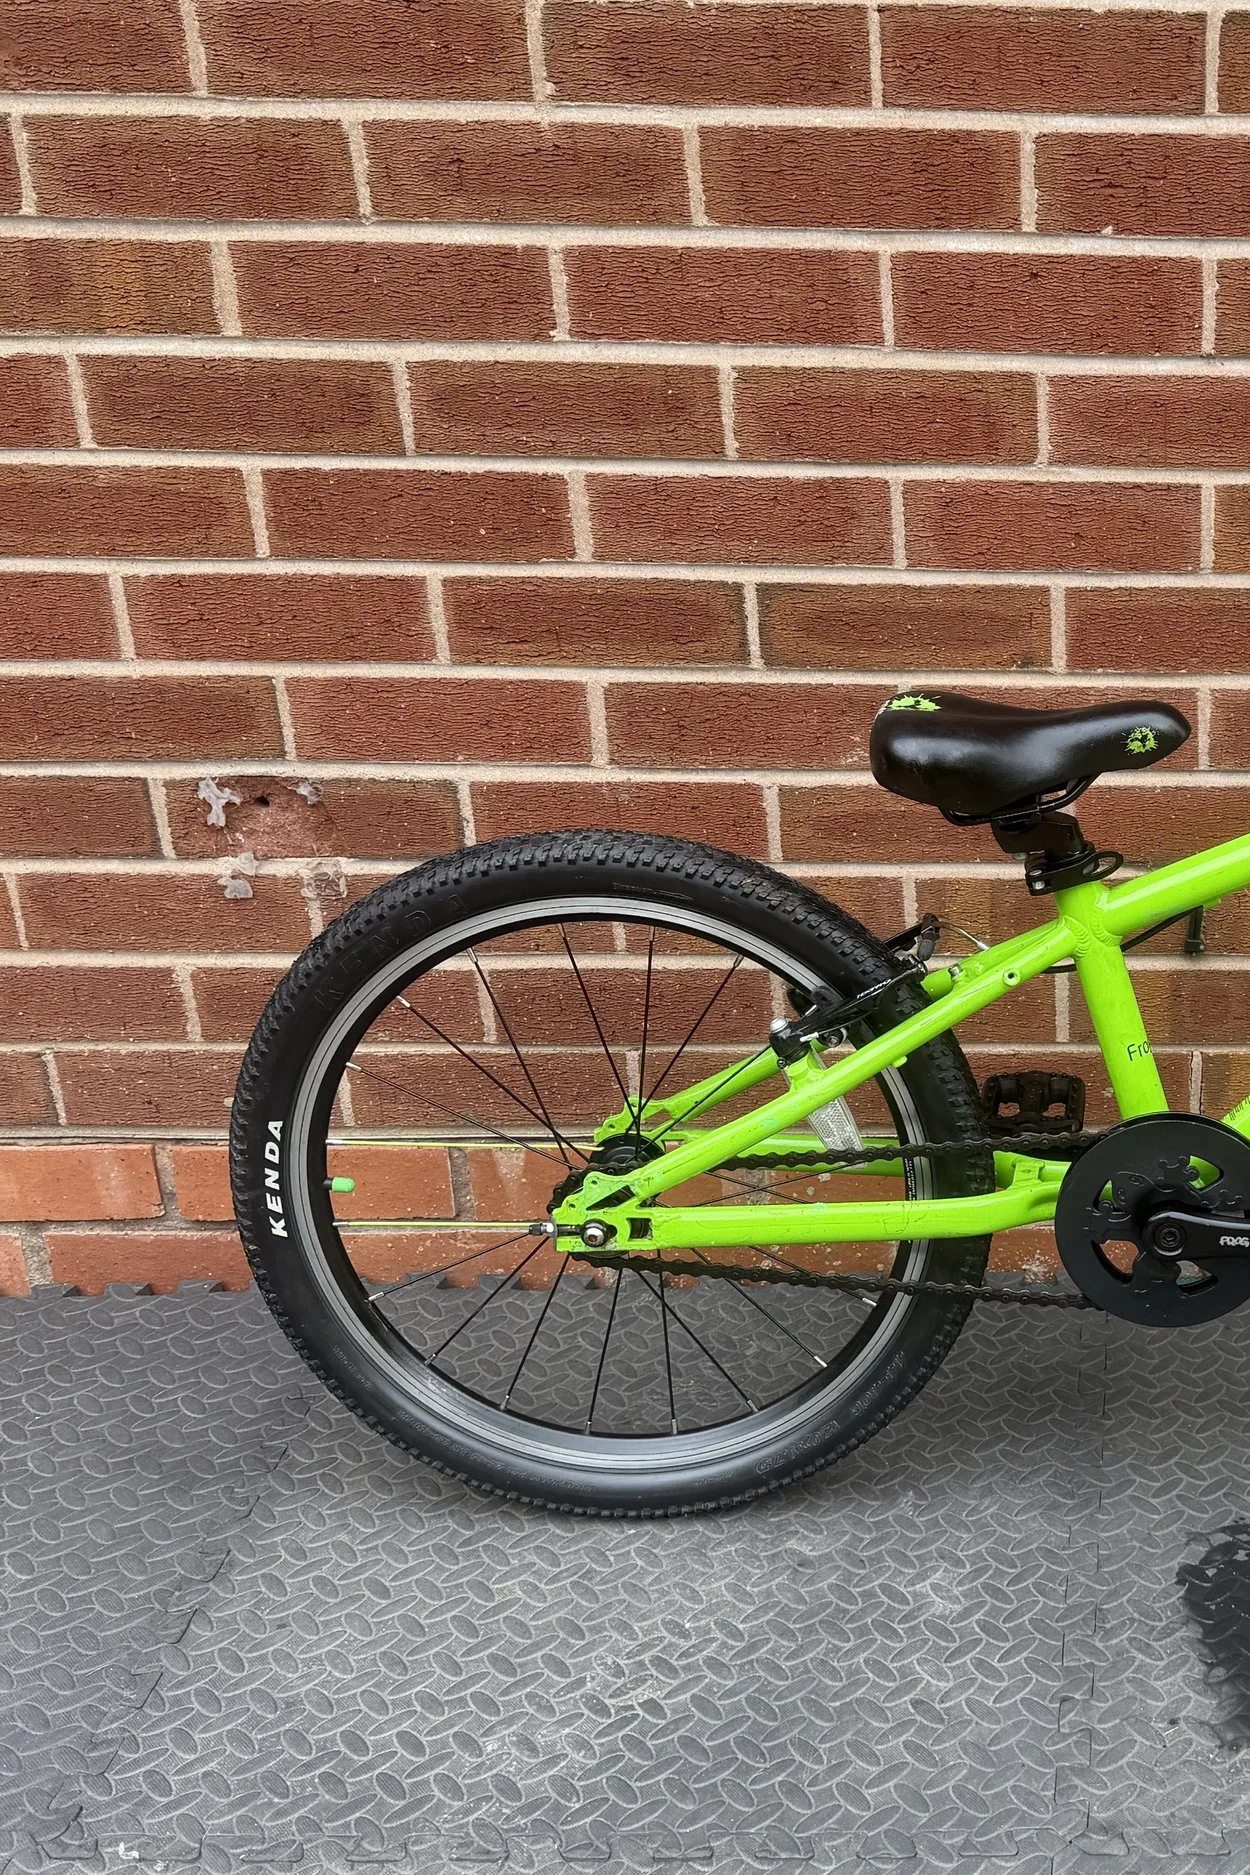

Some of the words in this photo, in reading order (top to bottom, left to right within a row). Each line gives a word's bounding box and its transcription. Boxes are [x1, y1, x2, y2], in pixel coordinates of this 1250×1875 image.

[1127, 1041, 1153, 1062] Fro
[264, 1120, 289, 1238] KENDA
[1219, 1235, 1250, 1248] FROG
